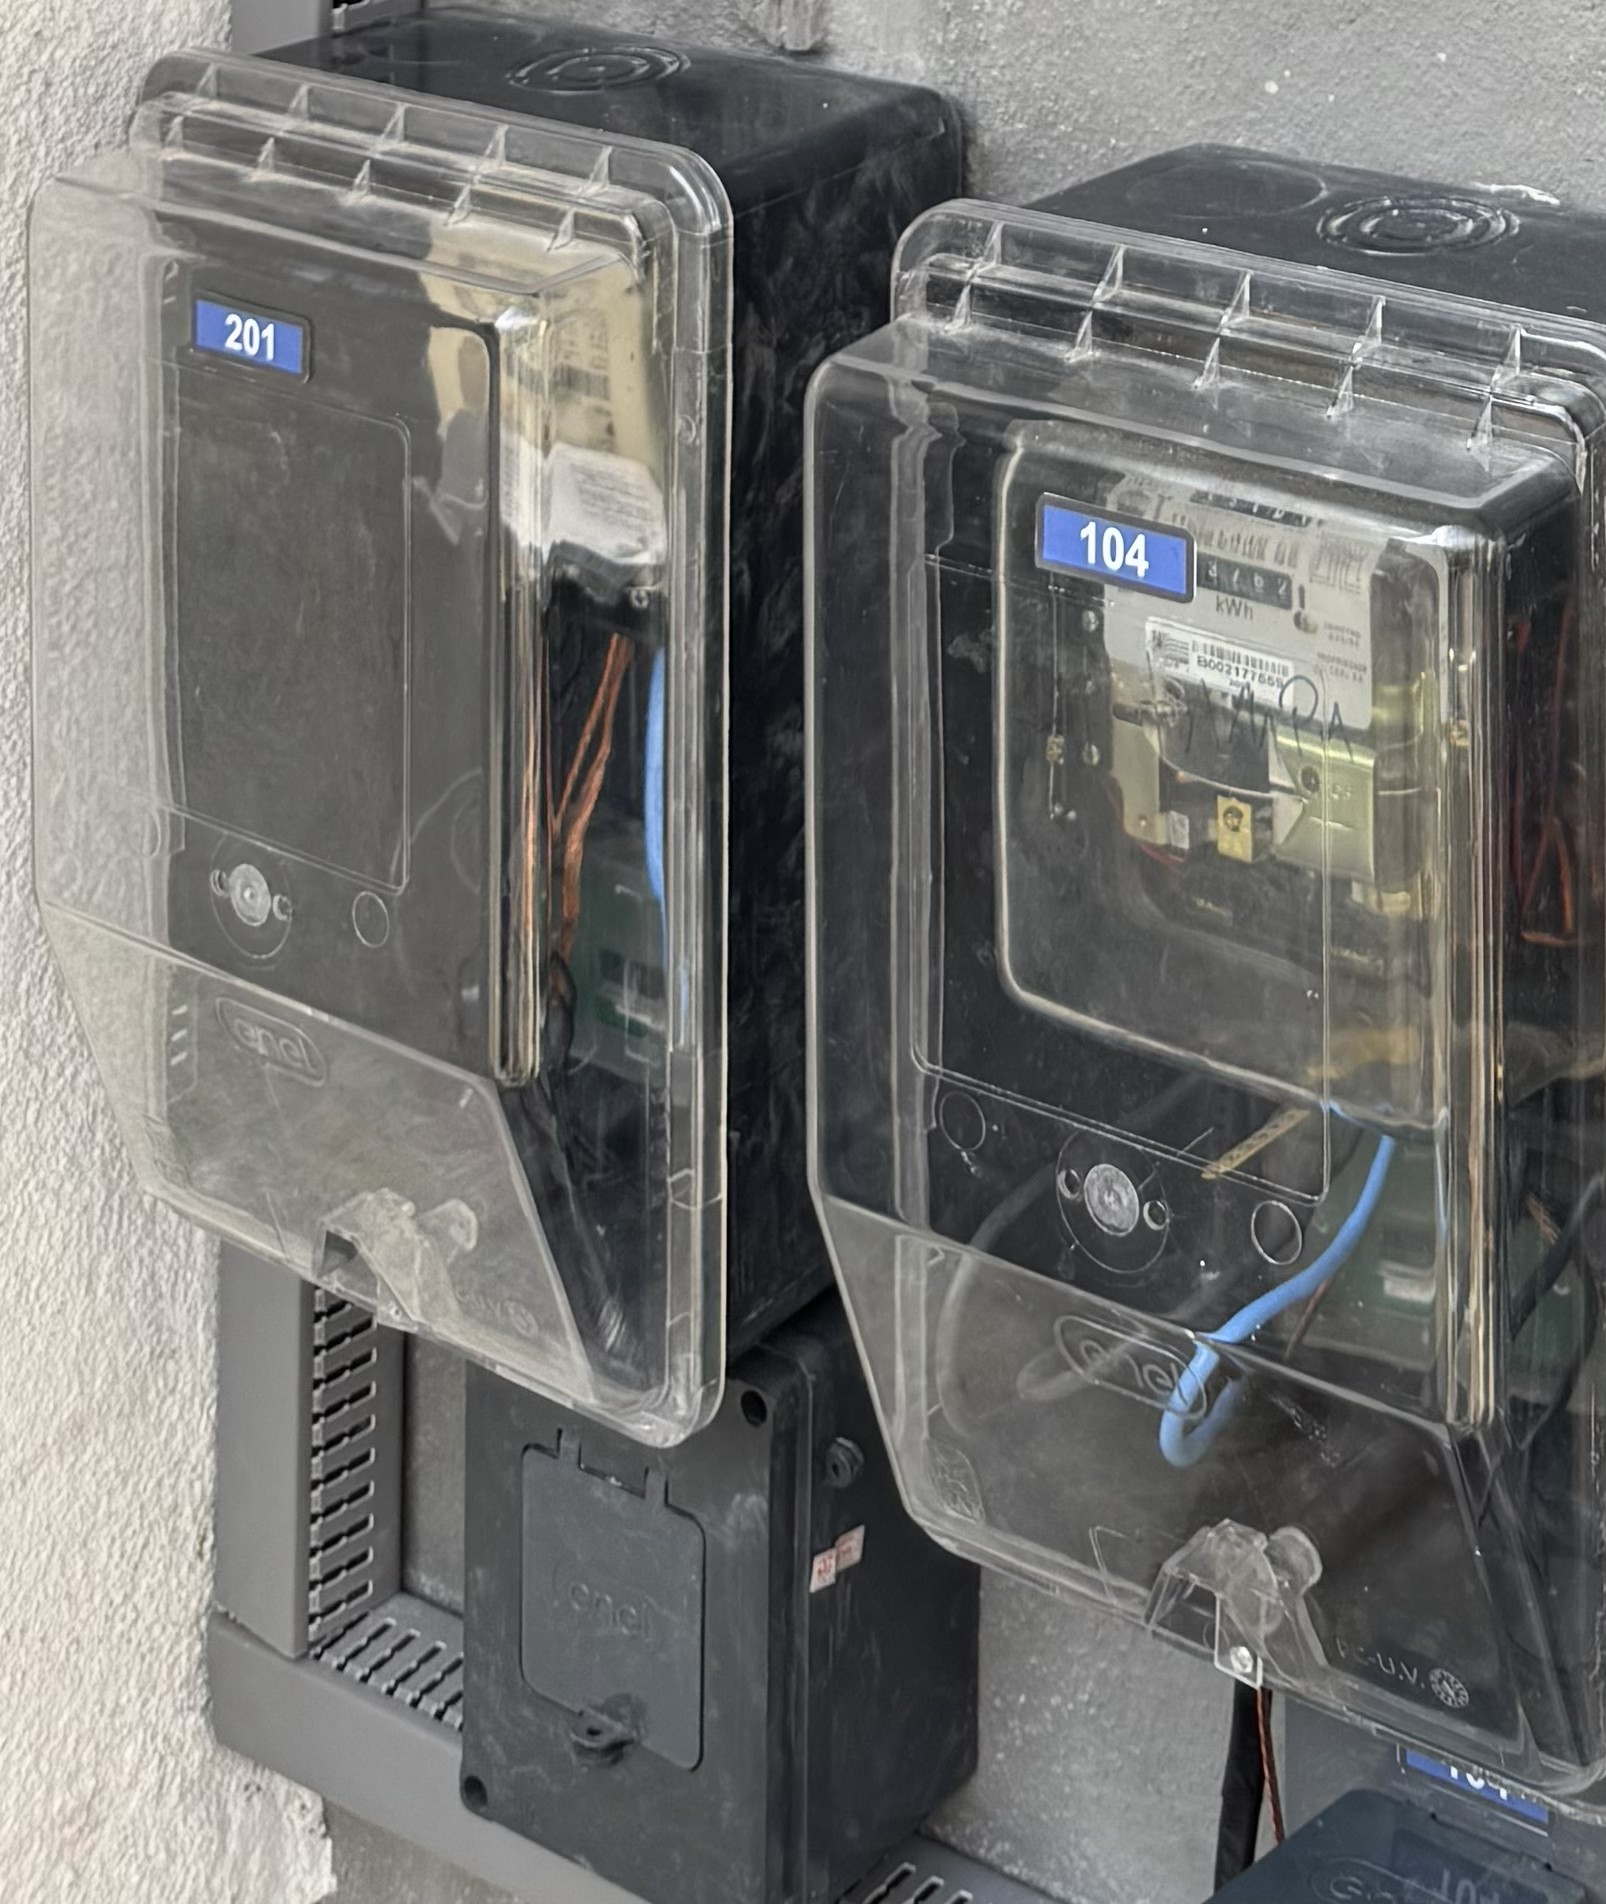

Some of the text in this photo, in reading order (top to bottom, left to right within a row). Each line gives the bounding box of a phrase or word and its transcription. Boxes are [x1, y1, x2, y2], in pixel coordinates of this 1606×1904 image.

[225, 314, 275, 361] 201
[1080, 521, 1149, 578] 104
[1216, 595, 1255, 621] kWh
[233, 1017, 313, 1073] enel
